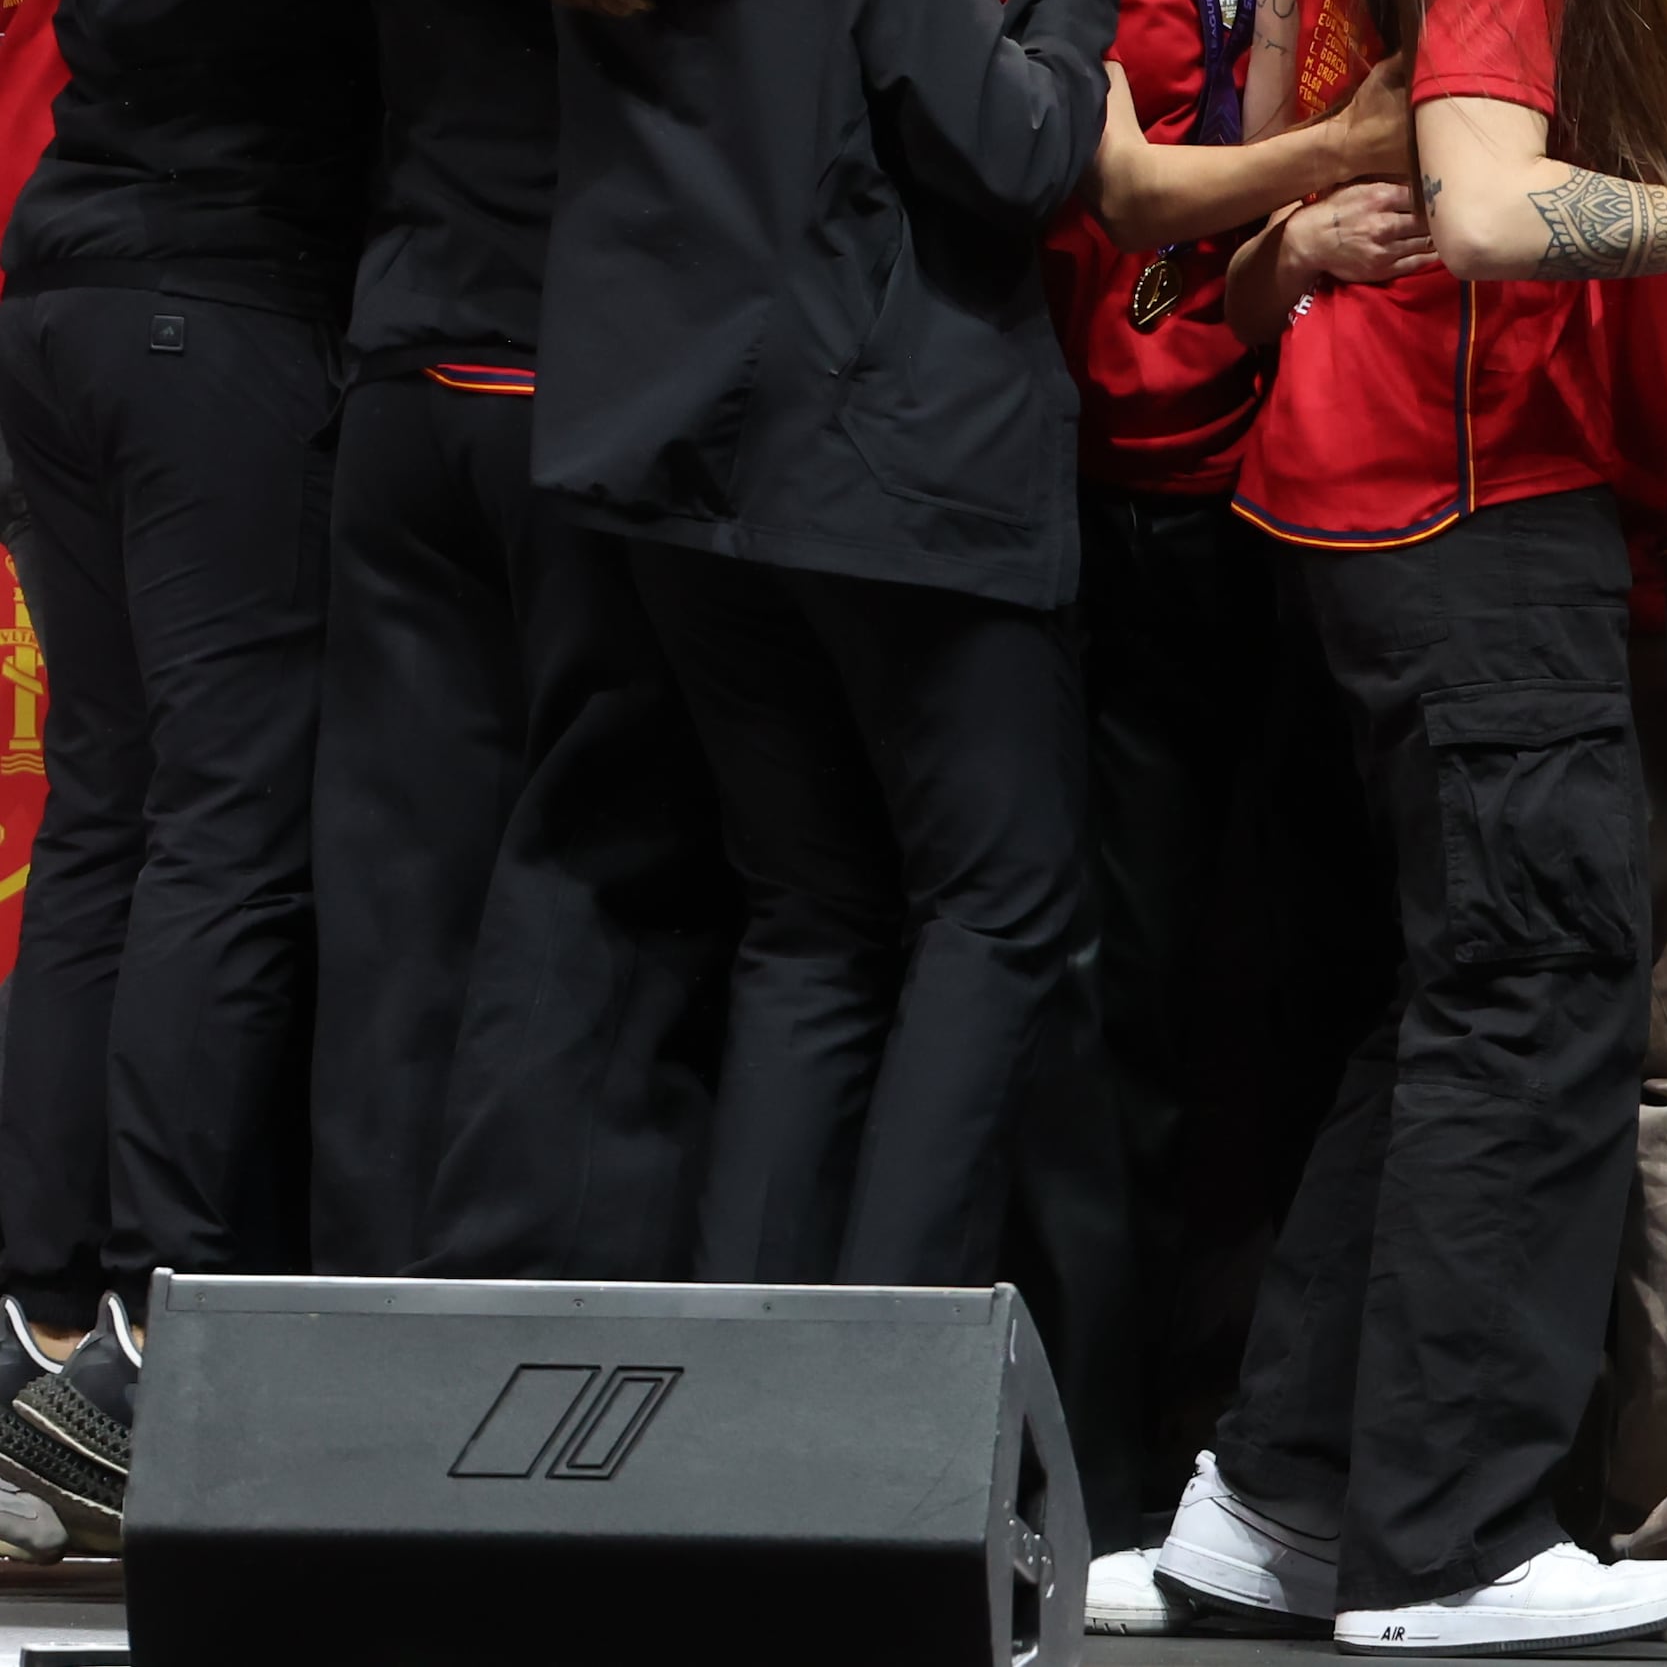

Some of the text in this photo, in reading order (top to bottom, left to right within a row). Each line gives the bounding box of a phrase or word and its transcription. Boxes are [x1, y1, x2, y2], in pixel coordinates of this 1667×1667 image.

[1301, 70, 1323, 94] OLGA
[1316, 62, 1339, 87] OROZ
[1380, 1625, 1406, 1642] AIR
